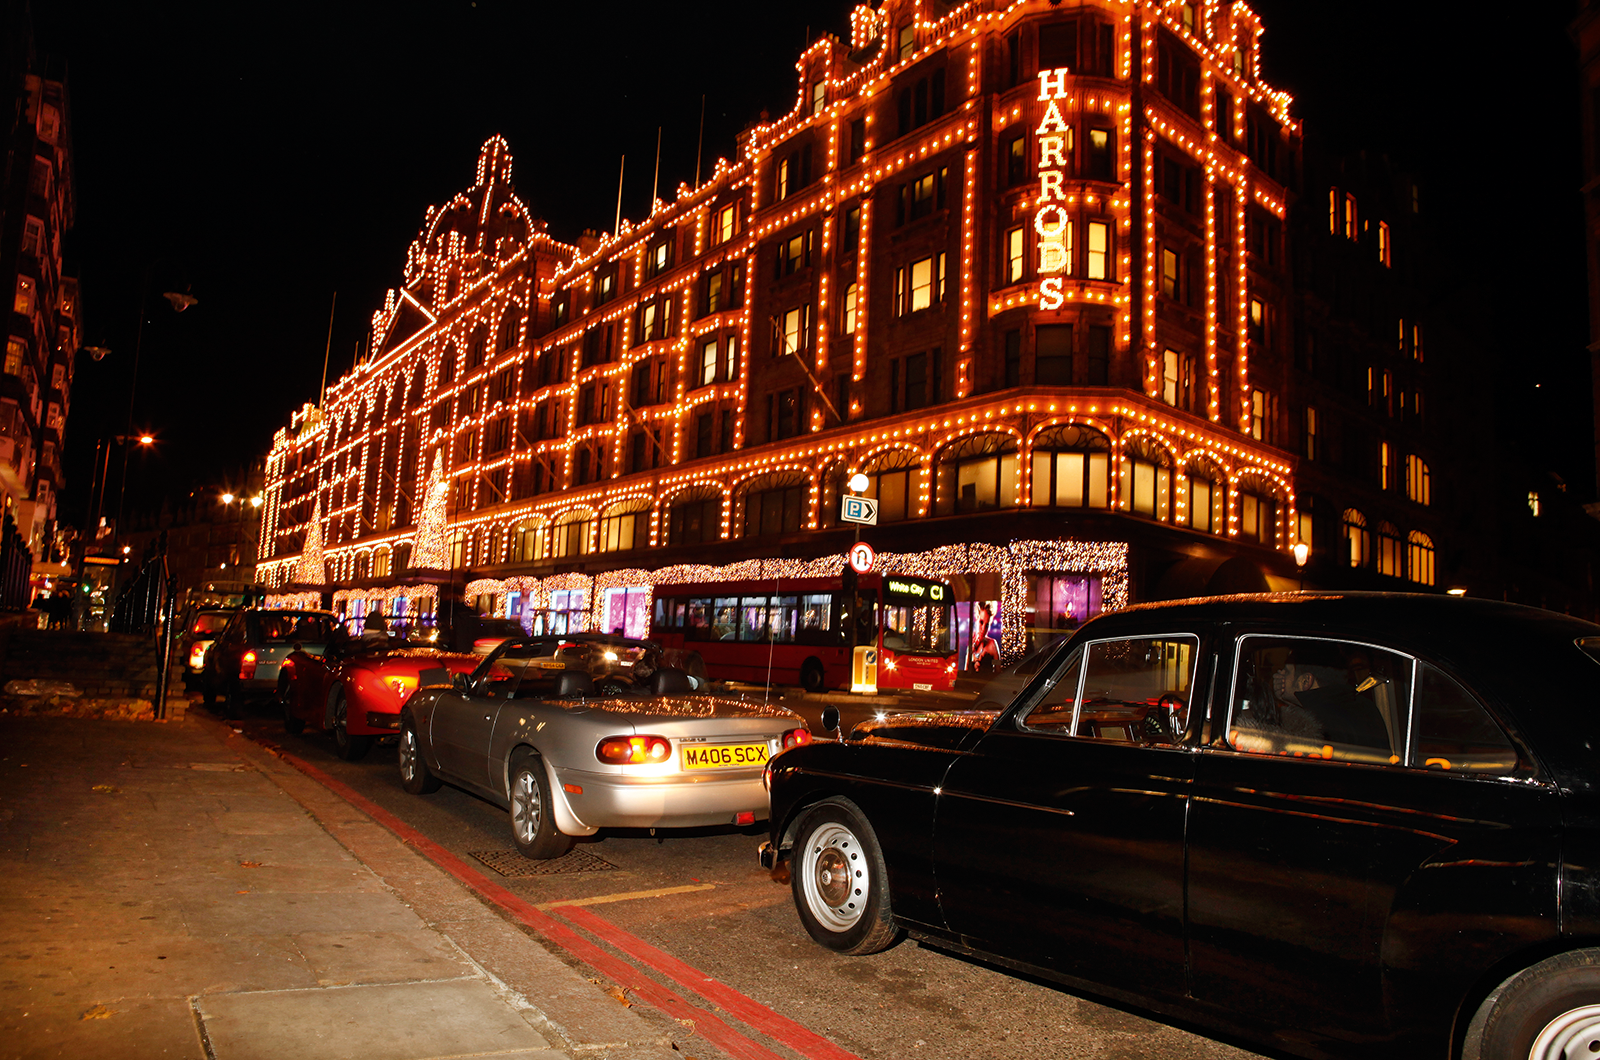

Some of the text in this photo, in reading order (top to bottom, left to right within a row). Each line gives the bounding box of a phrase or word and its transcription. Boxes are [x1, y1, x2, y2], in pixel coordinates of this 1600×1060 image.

[1034, 67, 1068, 311] HARRODS
[889, 581, 909, 593] White
[910, 583, 925, 597] City
[687, 746, 767, 765] M406 SCX
